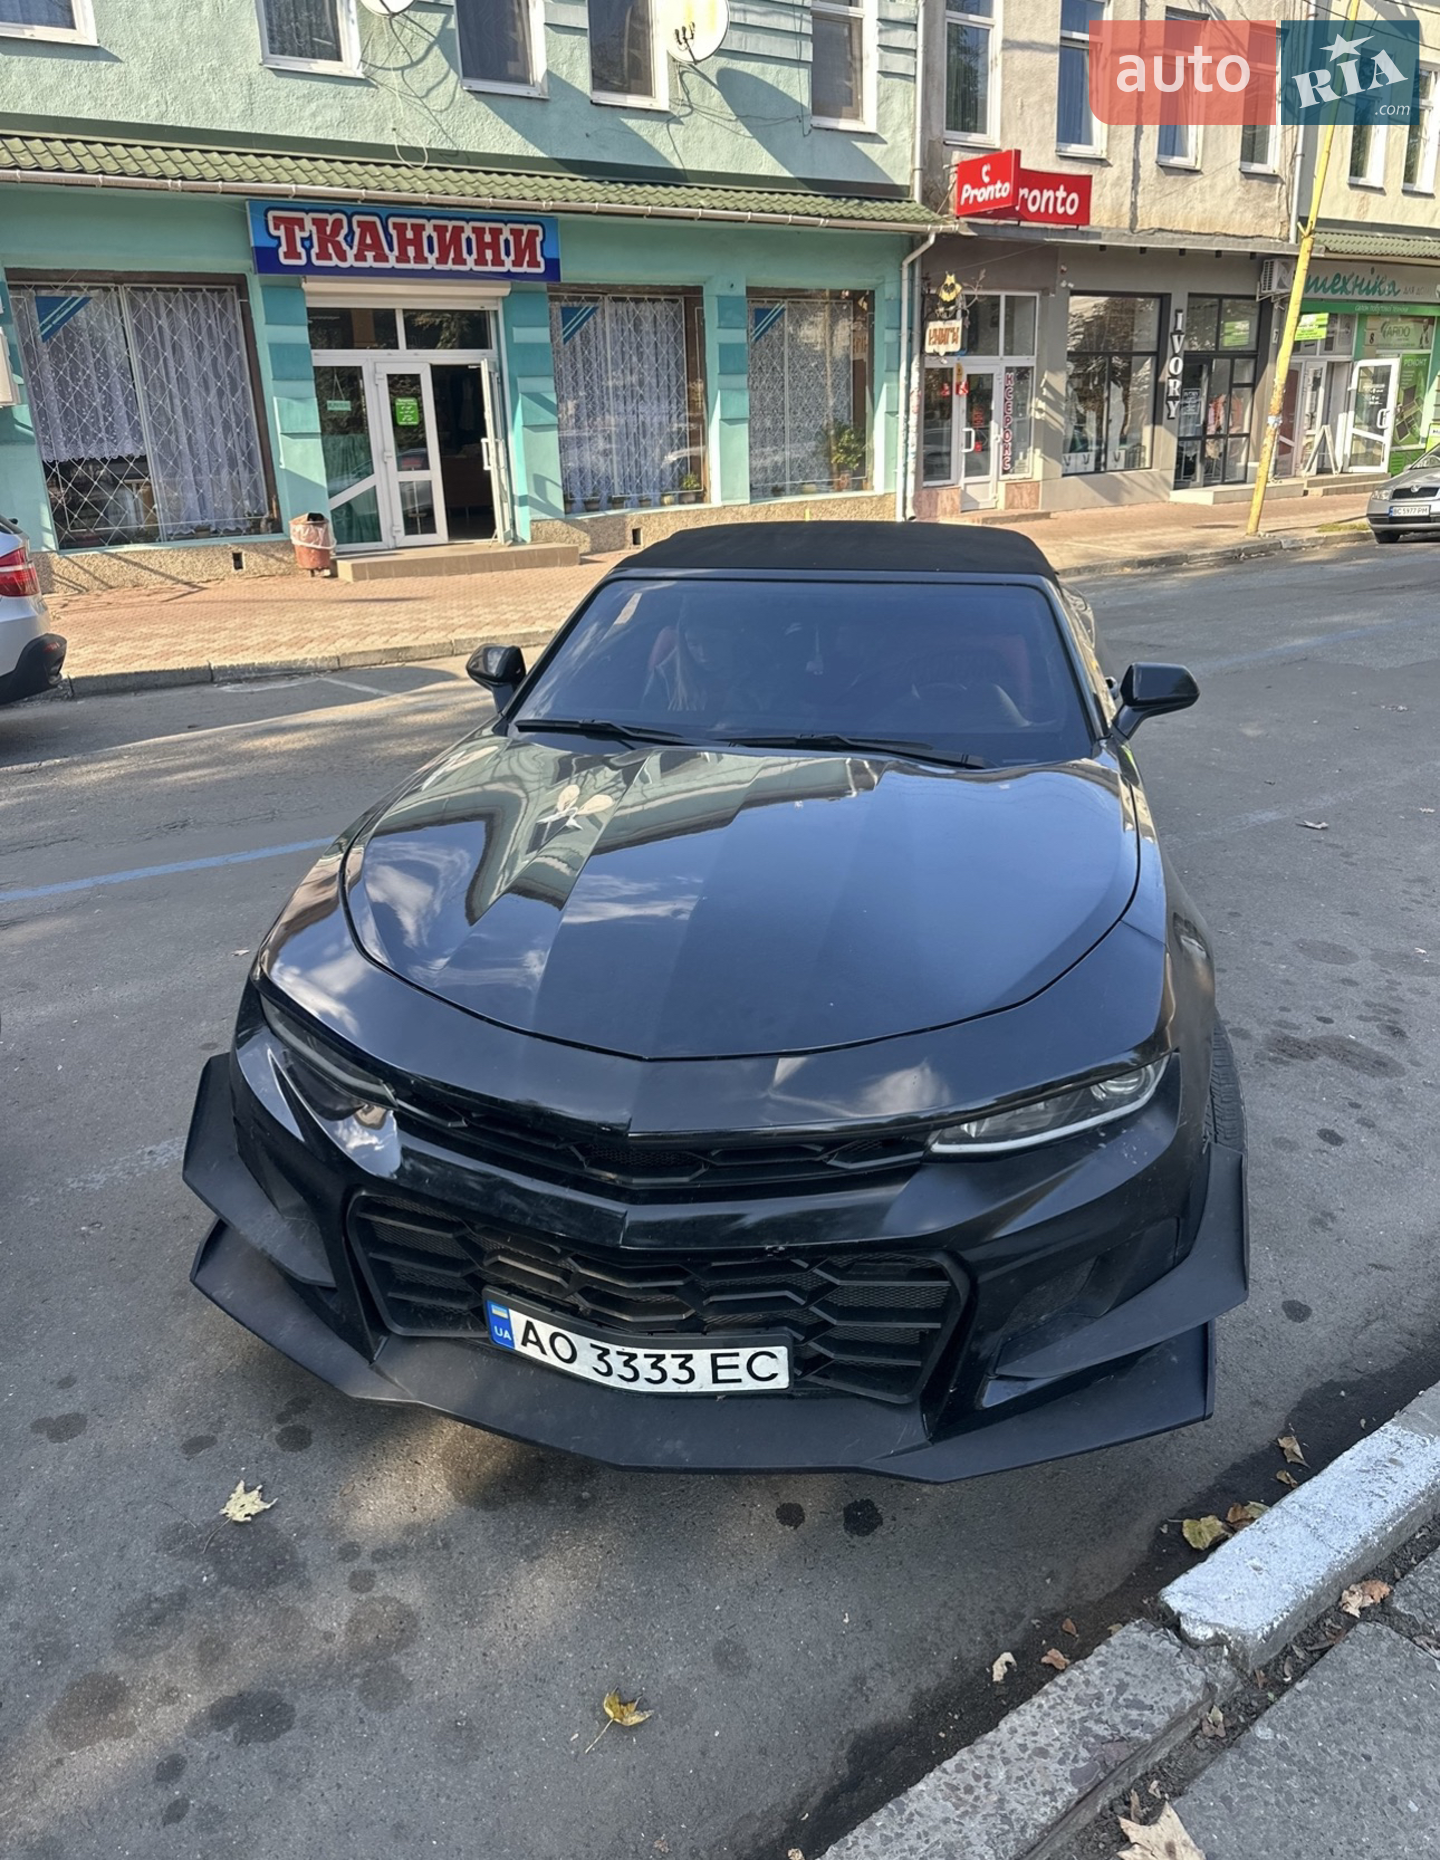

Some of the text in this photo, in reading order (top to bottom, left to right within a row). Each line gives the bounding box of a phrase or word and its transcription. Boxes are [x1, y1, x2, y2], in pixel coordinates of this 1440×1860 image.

[960, 180, 1010, 205] Pronto
[1015, 184, 1079, 215] ronto
[270, 213, 544, 271] ТКАНИНИ
[1304, 266, 1401, 297] техніка
[1167, 310, 1184, 419] IVORY
[1003, 373, 1014, 470] КСЕРОКС
[494, 1326, 511, 1341] UA
[521, 1320, 779, 1385] AO 3333 EC
